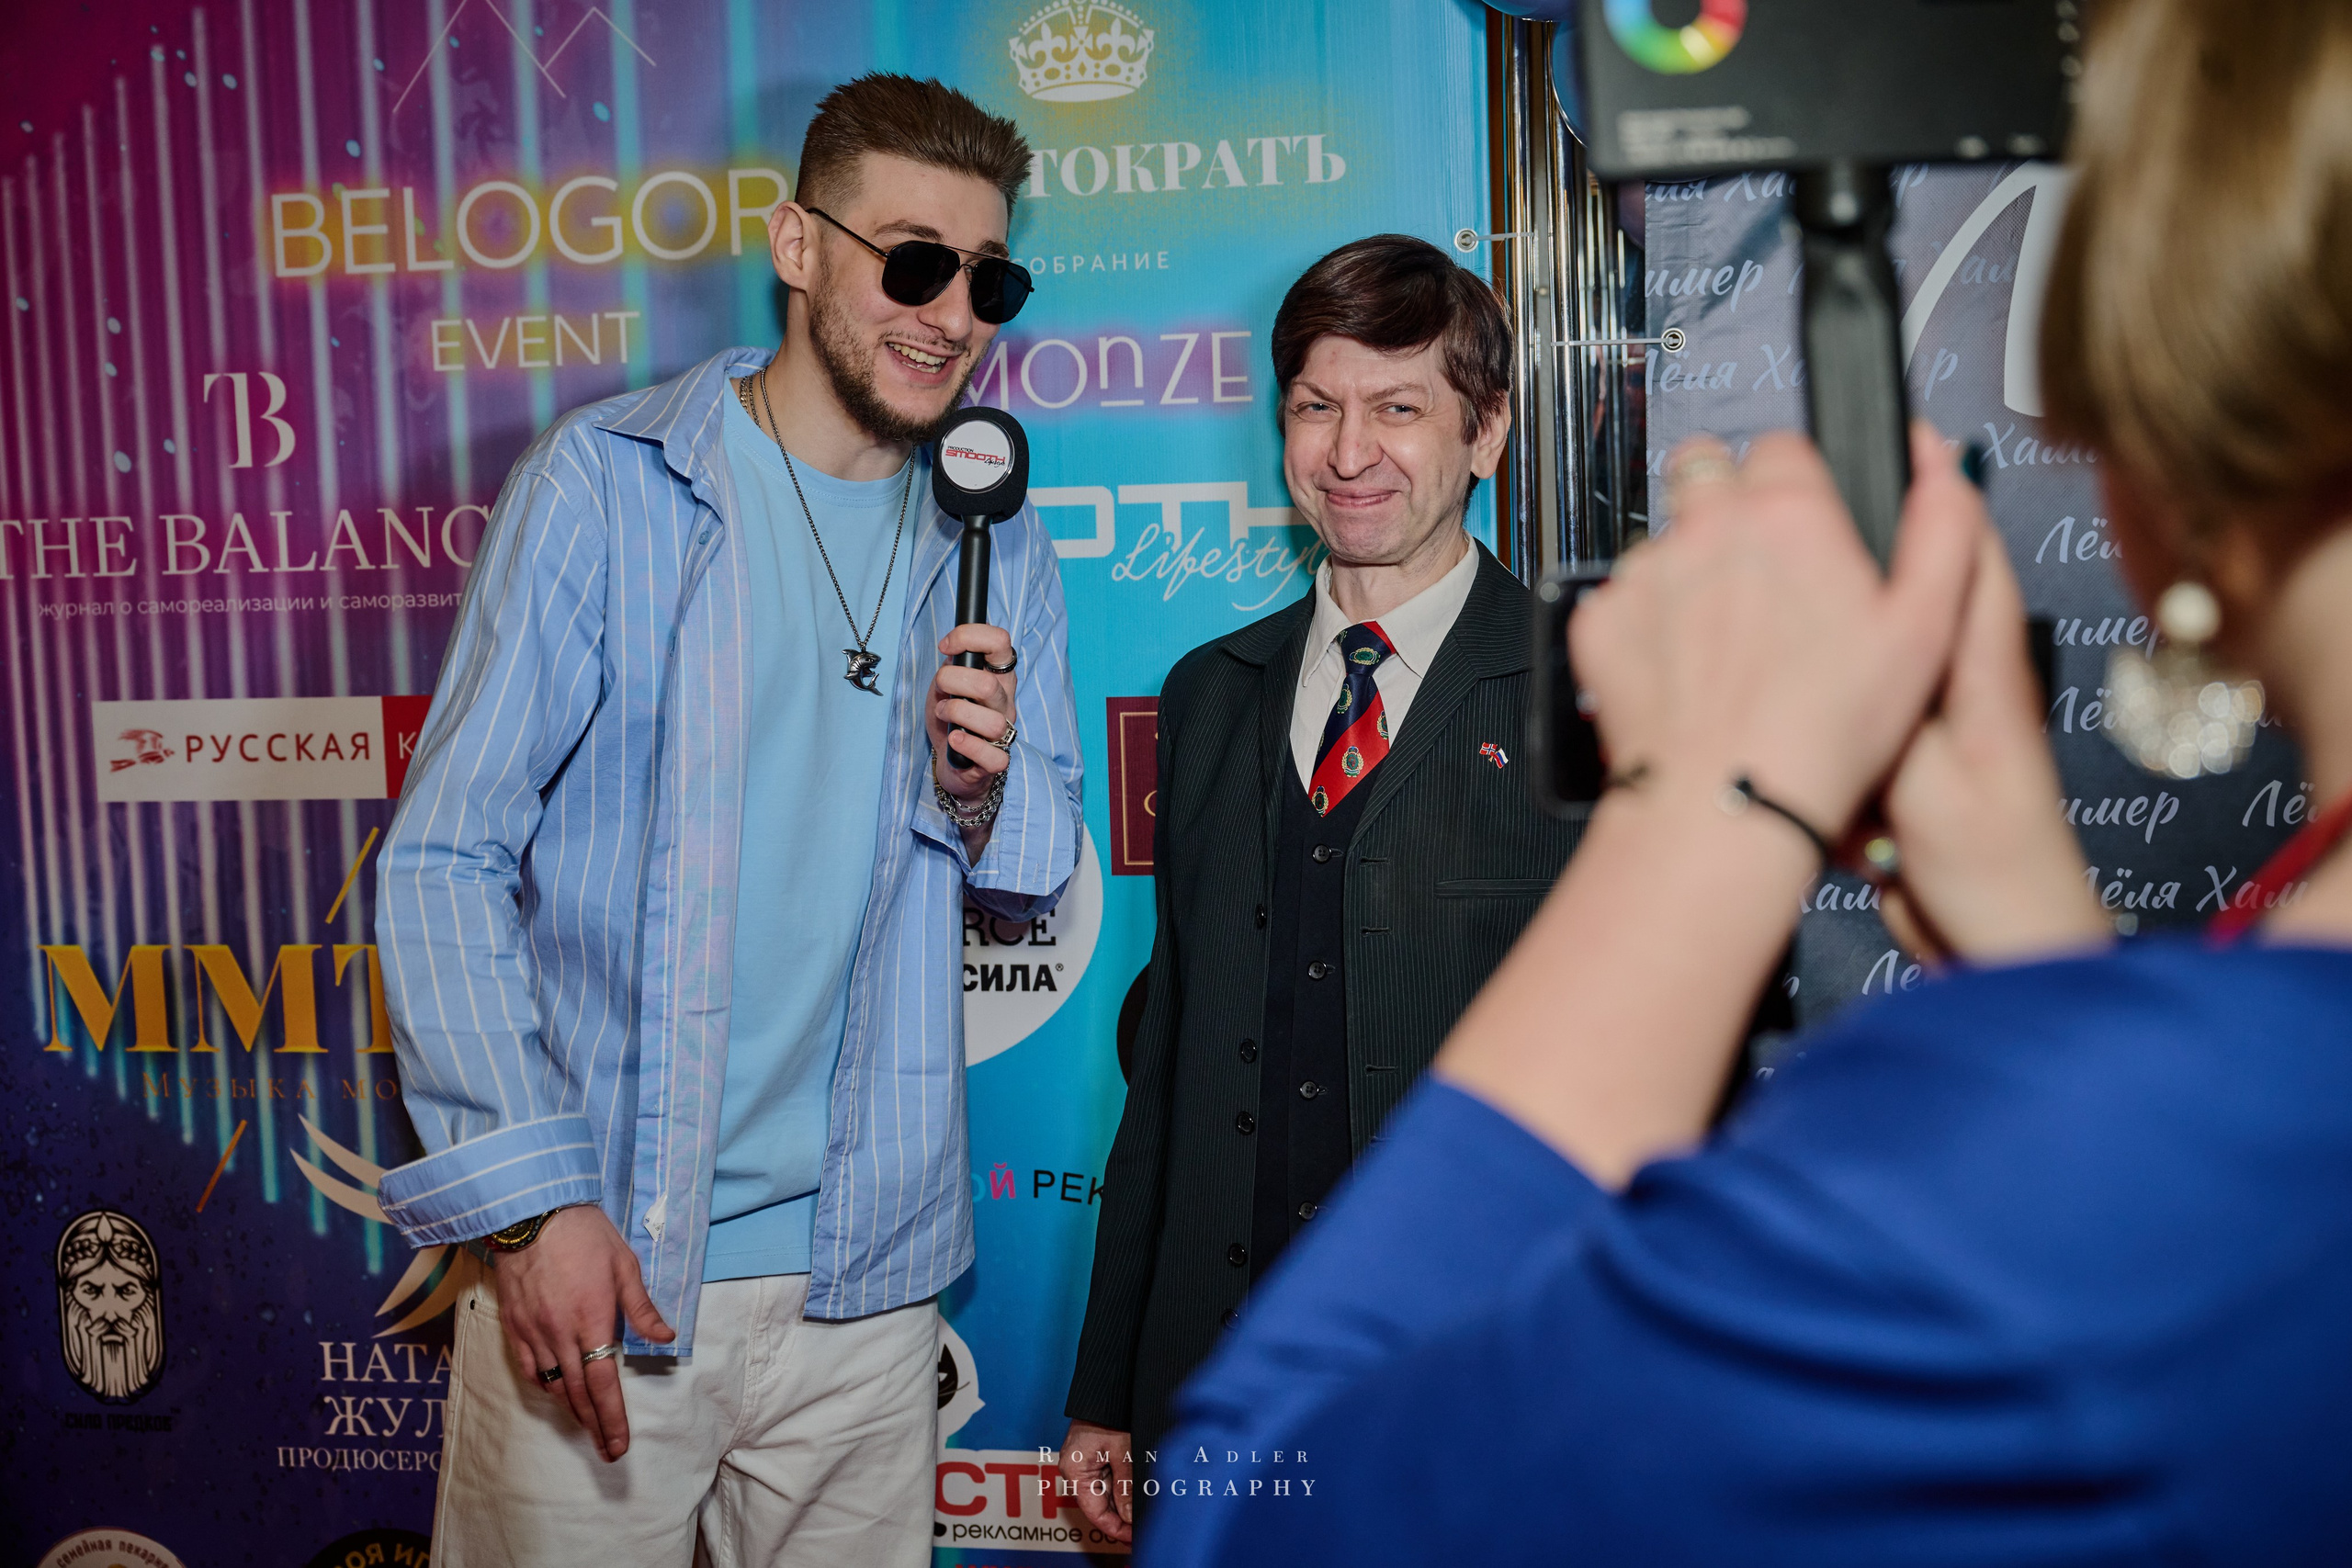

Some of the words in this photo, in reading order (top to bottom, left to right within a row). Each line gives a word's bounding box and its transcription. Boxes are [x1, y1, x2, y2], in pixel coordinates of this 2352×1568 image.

[271, 167, 791, 277] BELOGOR
[430, 310, 640, 372] EVENT
[945, 448, 1006, 462] SMOOTH
[159, 503, 490, 576] BALANC
[39, 600, 113, 620] журнал
[120, 601, 132, 615] о
[138, 596, 314, 618] самореализации
[320, 596, 334, 610] и
[339, 592, 463, 612] саморазвит
[186, 732, 370, 763] РУССКАЯ
[953, 1523, 1083, 1543] рекламное
